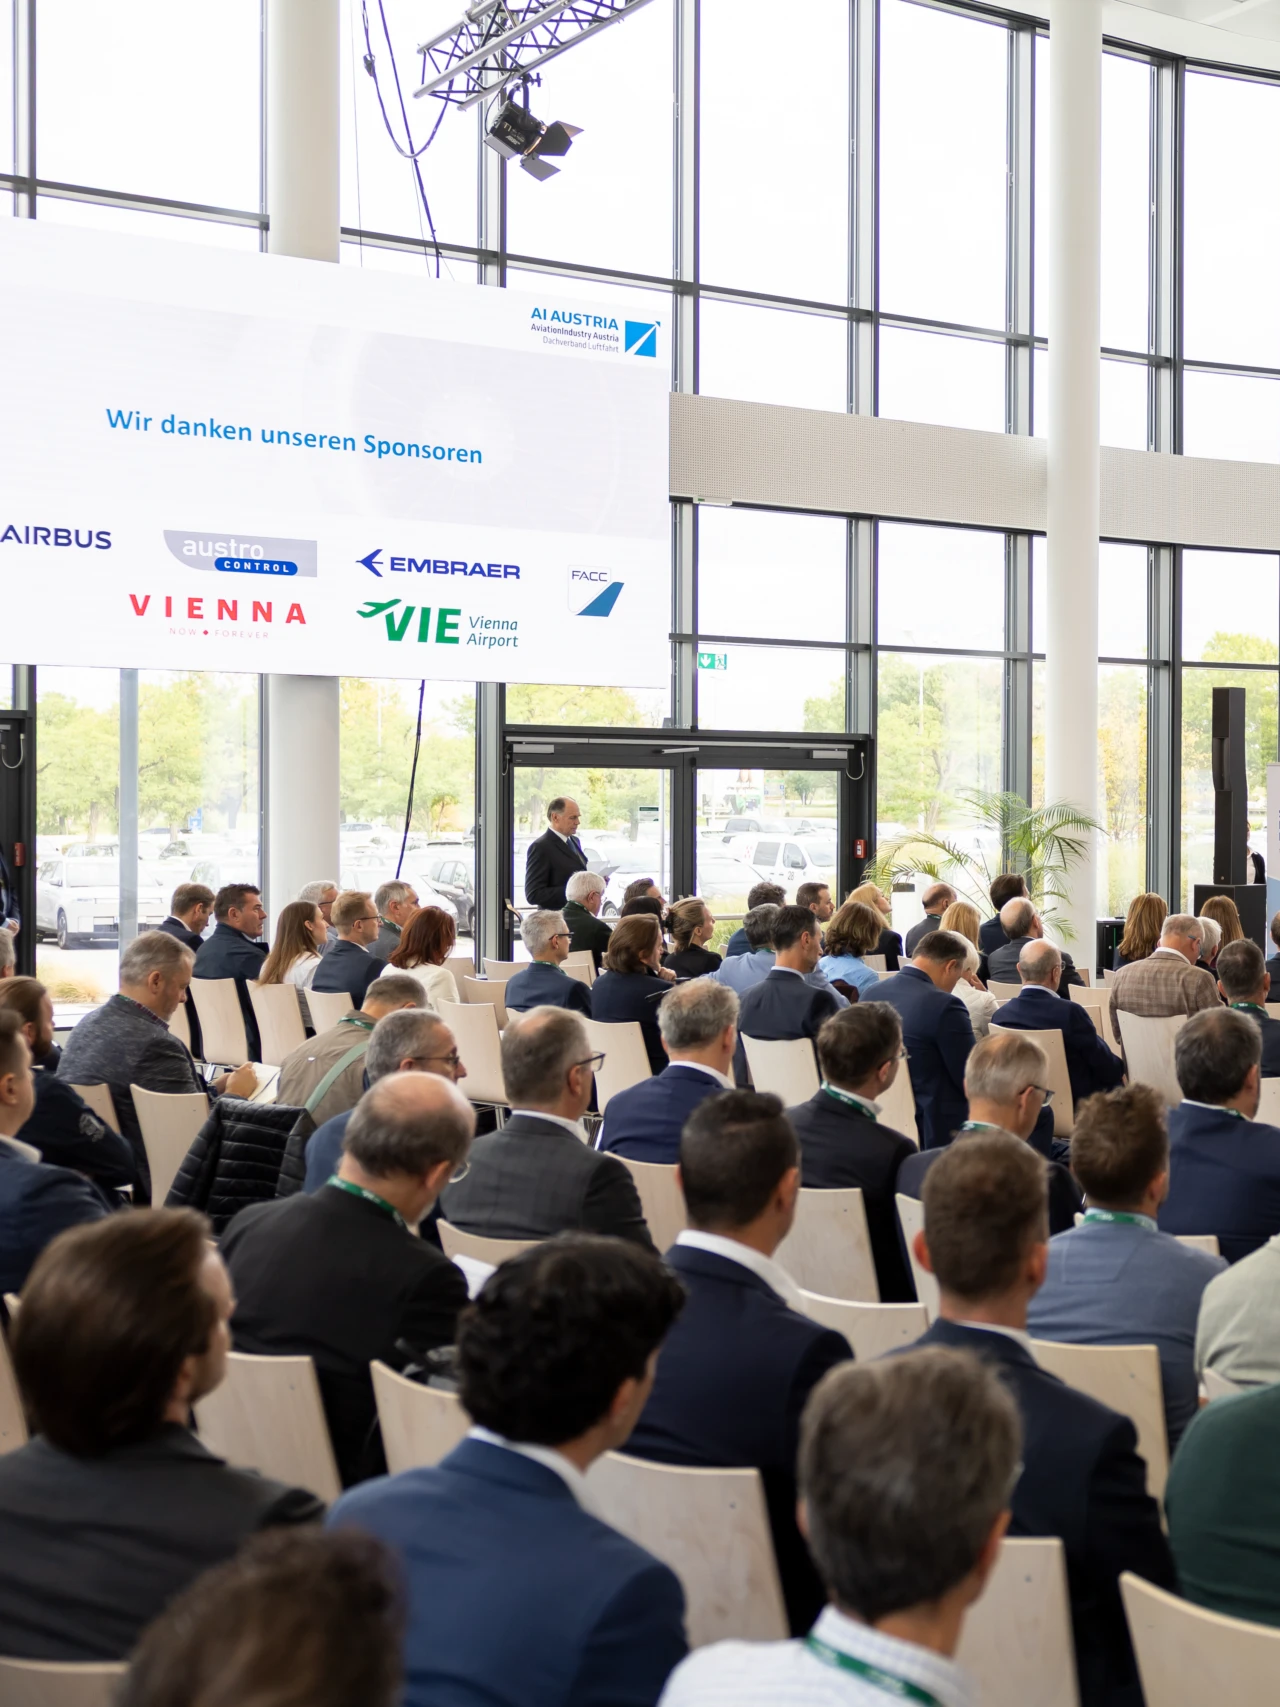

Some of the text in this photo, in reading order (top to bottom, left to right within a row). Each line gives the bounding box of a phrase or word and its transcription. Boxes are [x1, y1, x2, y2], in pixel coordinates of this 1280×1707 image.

[531, 307, 619, 330] AI AUSTRIA
[531, 323, 619, 343] AviationIndustry Austria
[543, 336, 619, 353] Dachverband Luftfahrt
[106, 408, 483, 464] Wir danken unseren Sponsoren
[0, 524, 112, 550] AIRBUS
[182, 538, 264, 560] austro
[223, 560, 289, 573] CONTROL
[390, 556, 520, 580] EMBRAER
[571, 570, 608, 582] FACC
[128, 594, 307, 624] VIENNA
[169, 627, 269, 639] NOW FOREVER
[385, 606, 461, 644] VIE
[468, 616, 518, 631] Vienna
[467, 633, 519, 649] Airport
